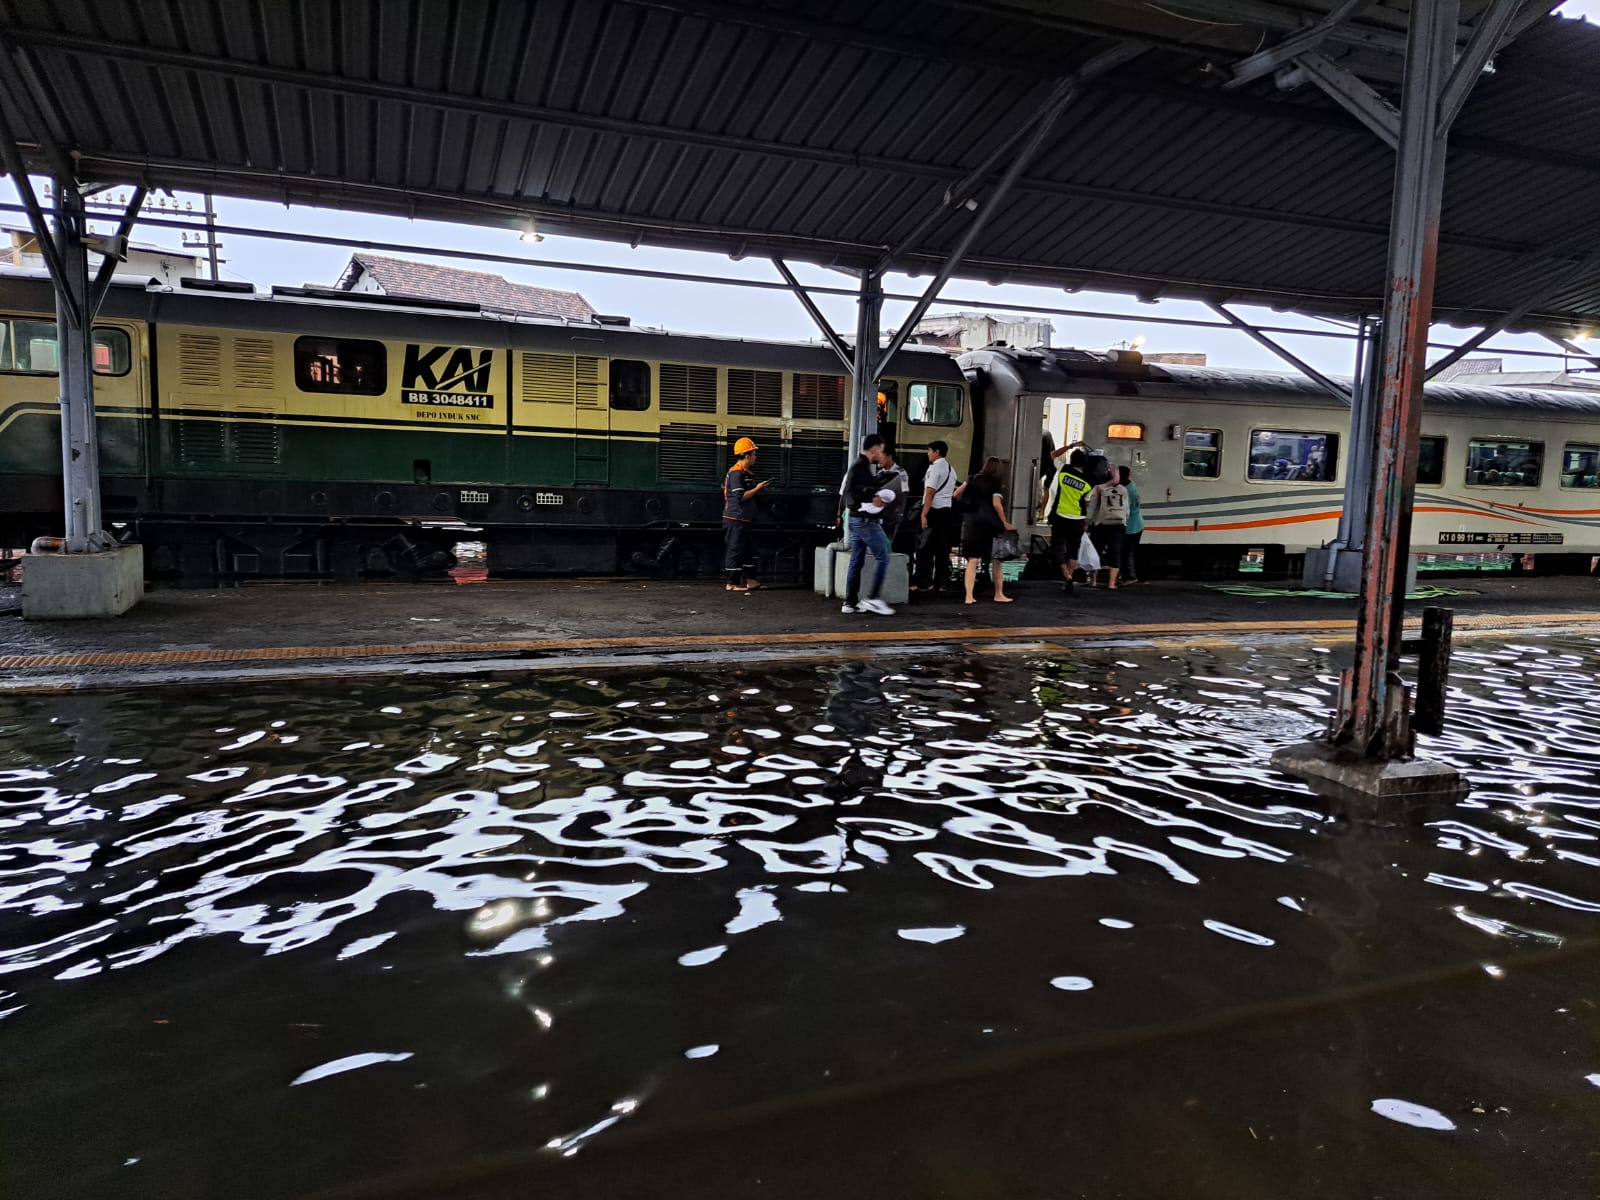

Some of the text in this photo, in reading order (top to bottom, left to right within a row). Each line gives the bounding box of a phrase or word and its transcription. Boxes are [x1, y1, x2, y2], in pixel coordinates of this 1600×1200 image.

[402, 344, 493, 393] KAI
[408, 392, 488, 407] BB 3048411
[416, 411, 437, 419] DEPO
[439, 412, 463, 420] INDUK
[1063, 475, 1085, 491] SATPAM
[1440, 533, 1449, 542] K1
